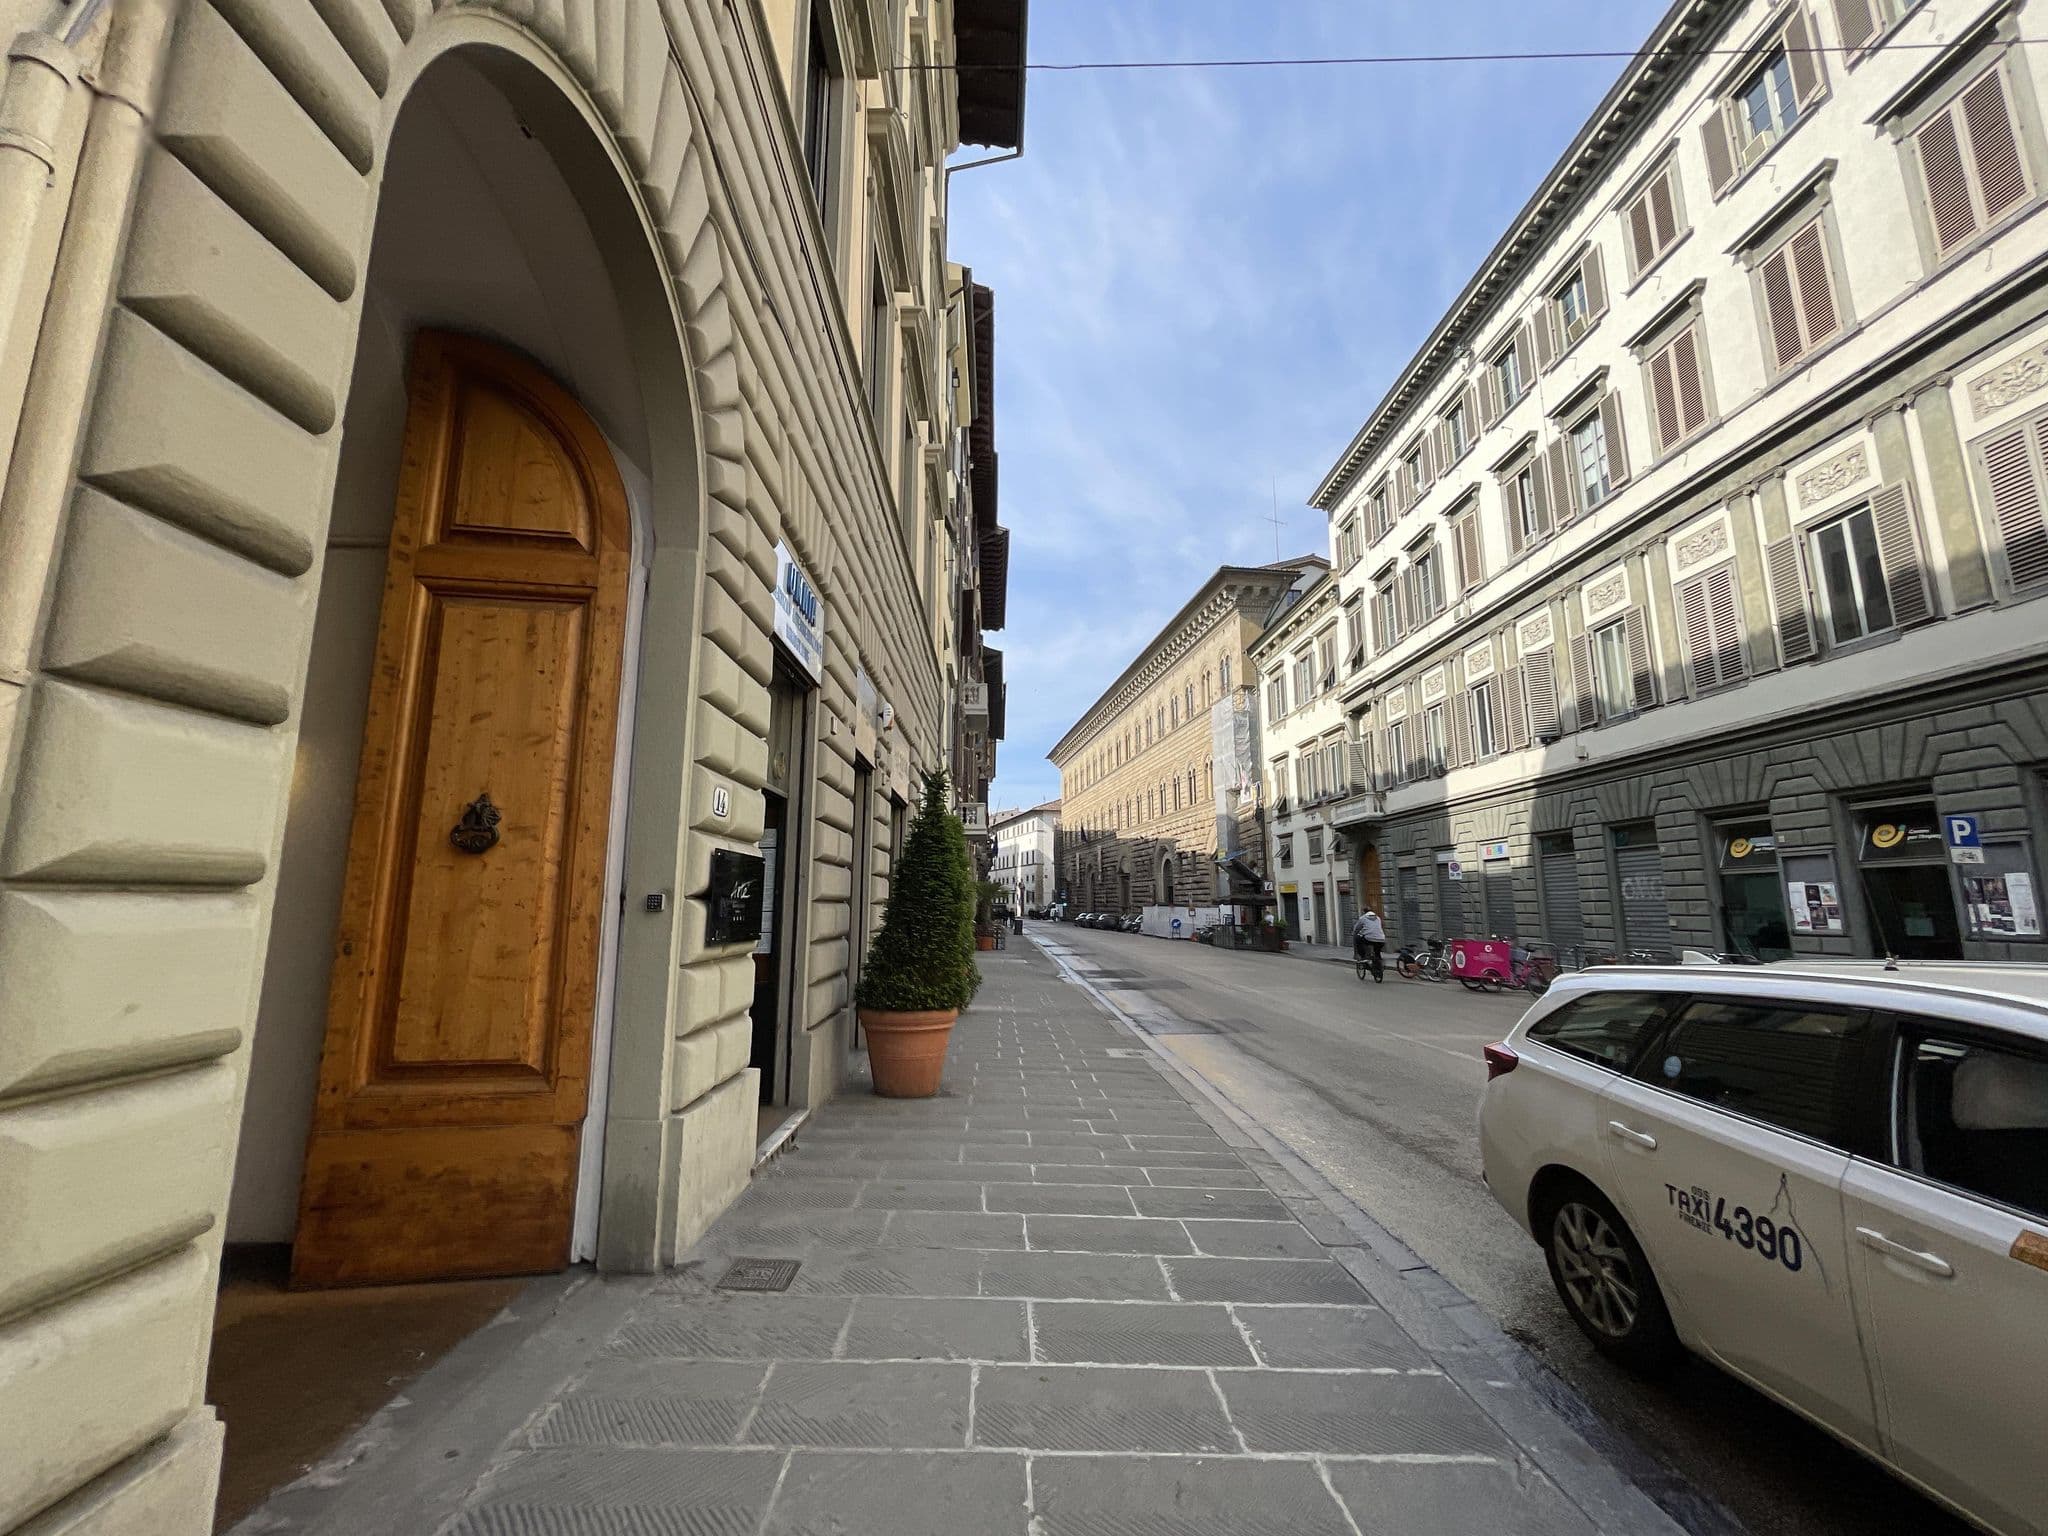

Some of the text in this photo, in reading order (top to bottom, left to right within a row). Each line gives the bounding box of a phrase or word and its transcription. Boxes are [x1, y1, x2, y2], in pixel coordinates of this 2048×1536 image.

[716, 789, 726, 813] 14
[1951, 820, 1971, 844] P
[1665, 1183, 1802, 1272] TAXI 4390
